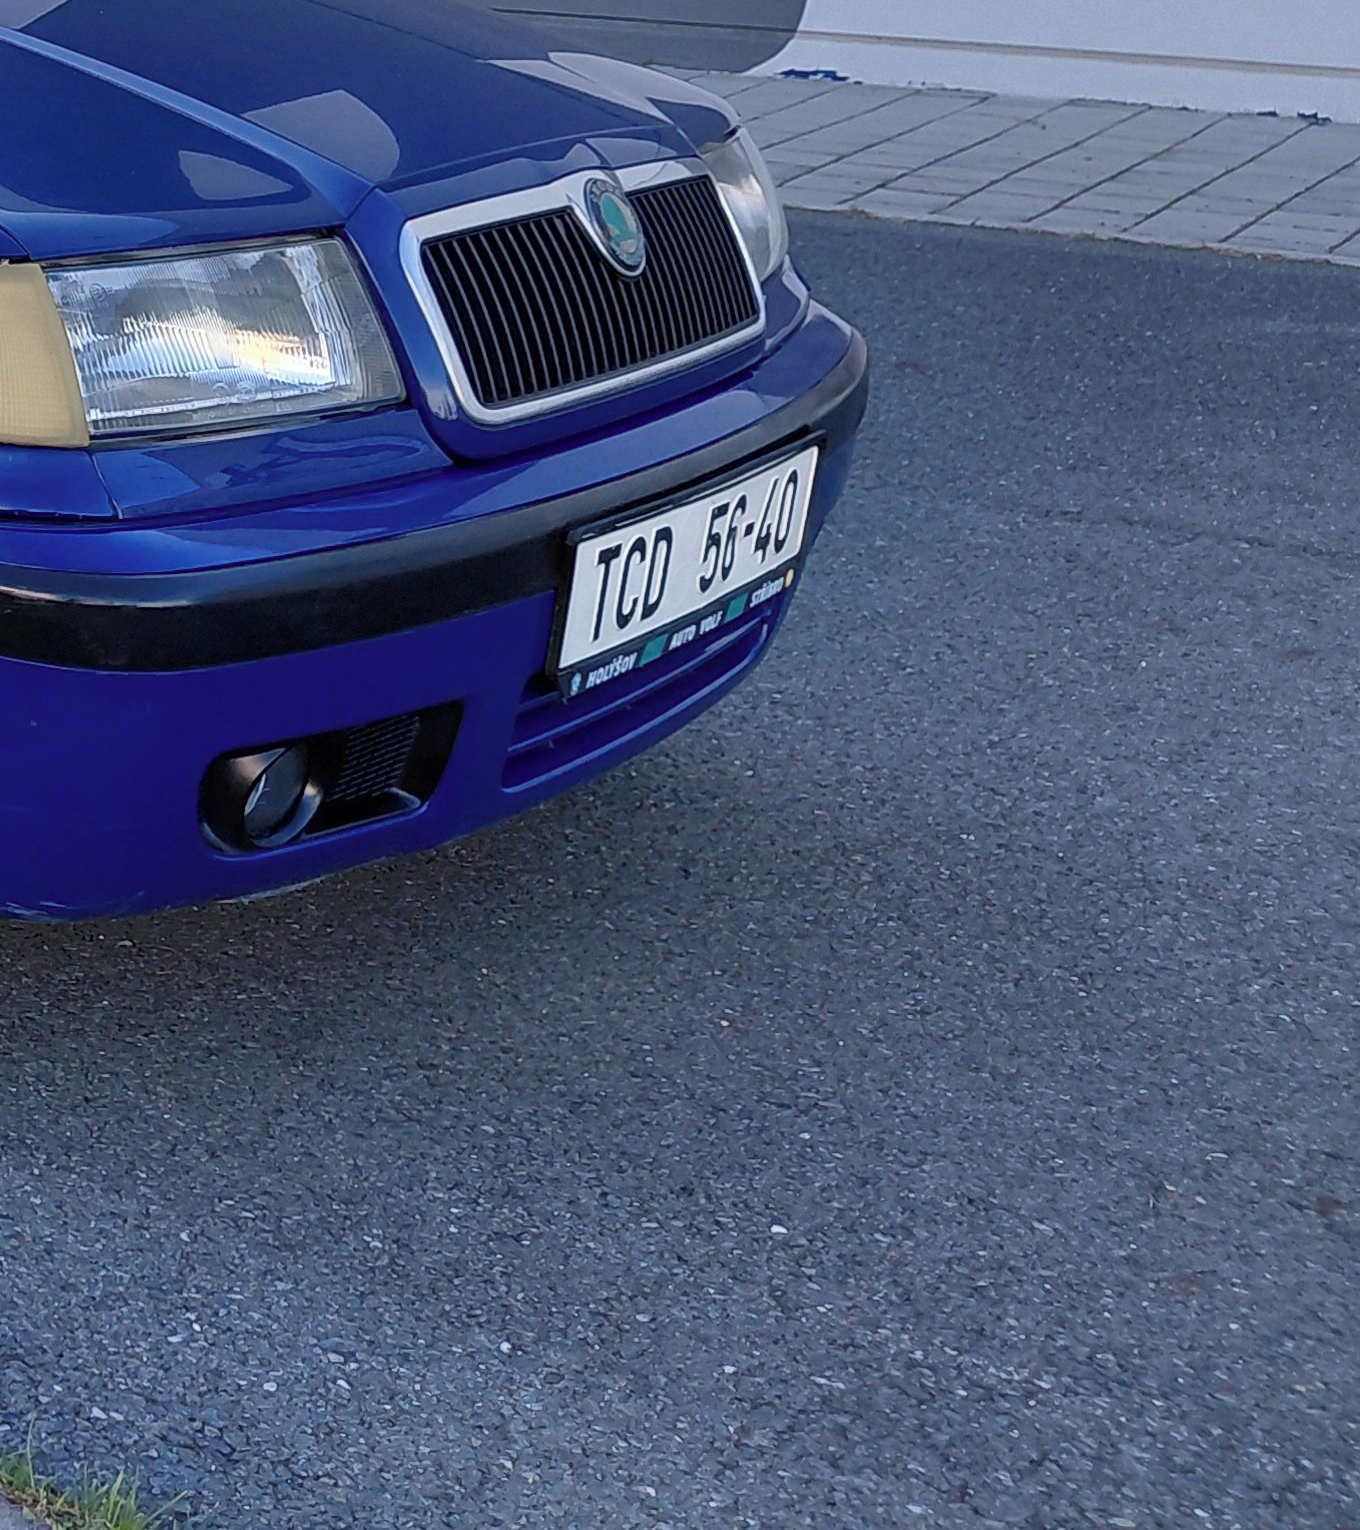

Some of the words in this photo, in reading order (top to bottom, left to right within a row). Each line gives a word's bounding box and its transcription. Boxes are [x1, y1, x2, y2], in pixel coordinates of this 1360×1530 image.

[592, 526, 673, 643] TCD
[698, 468, 798, 593] 56-40
[668, 624, 696, 651] AUTO
